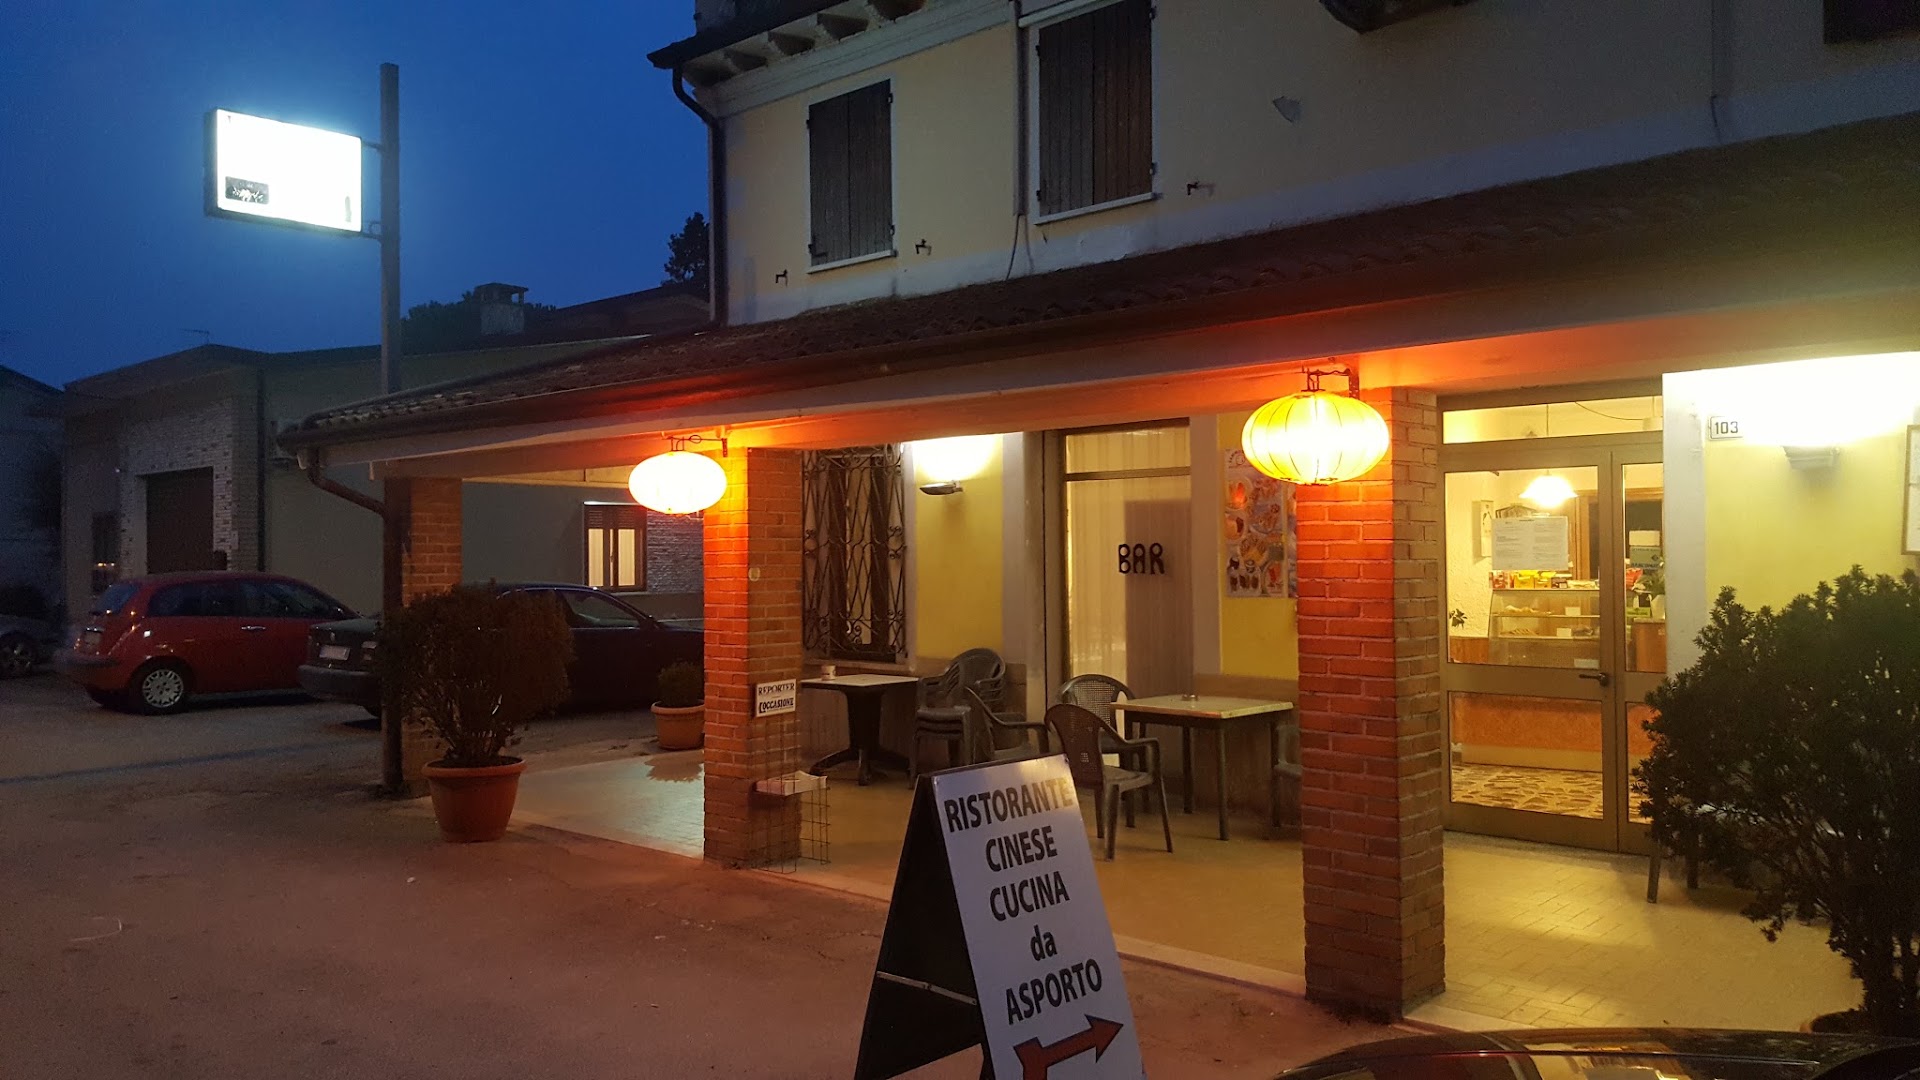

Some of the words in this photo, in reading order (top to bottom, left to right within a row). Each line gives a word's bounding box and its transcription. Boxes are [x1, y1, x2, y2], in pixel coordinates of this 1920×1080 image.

[1714, 421, 1739, 434] 103
[1118, 542, 1165, 575] BAR
[758, 683, 795, 696] REPORTER
[944, 777, 1074, 833] RISTORANTE
[985, 825, 1057, 872] CINESE
[989, 871, 1070, 922] CUCINA
[1030, 924, 1057, 961] da
[1005, 958, 1102, 1026] ASPORTO
